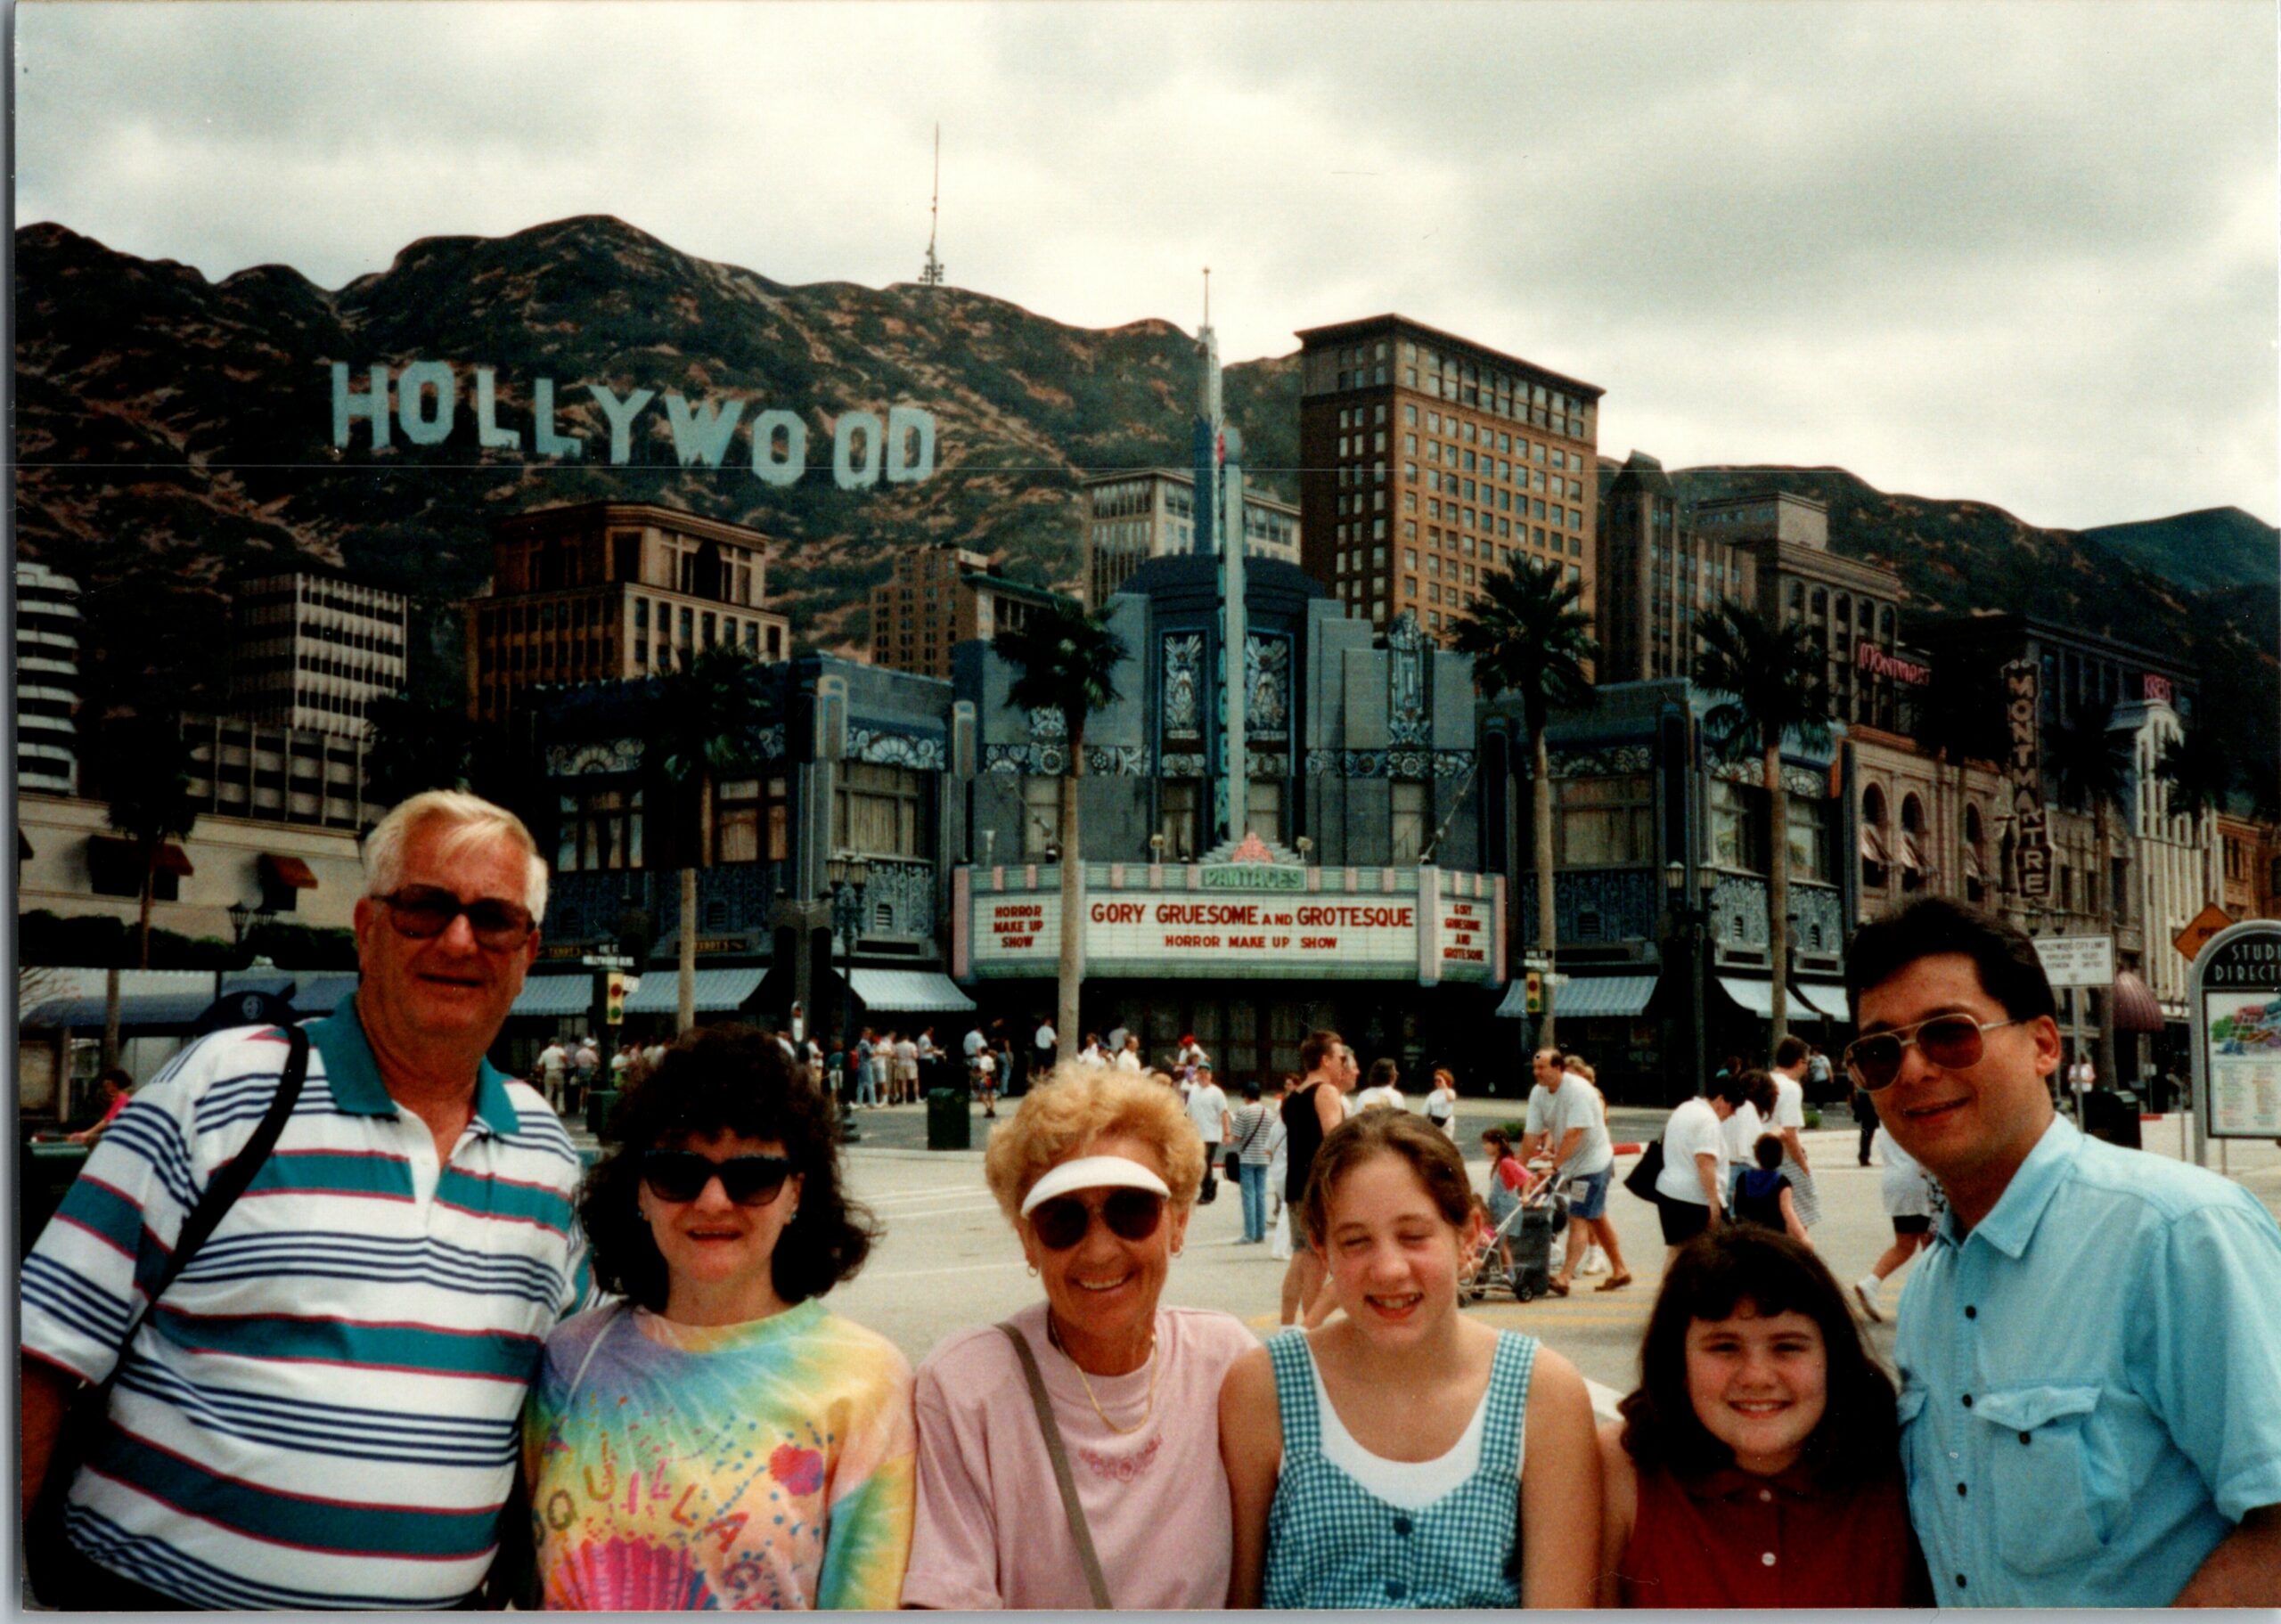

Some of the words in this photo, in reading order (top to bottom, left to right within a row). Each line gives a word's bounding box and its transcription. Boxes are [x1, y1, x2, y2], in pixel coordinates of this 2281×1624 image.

[331, 359, 936, 490] HOLLYWOOD
[2007, 674, 2046, 894] MONTMARTRE
[1205, 868, 1300, 887] PANTAGES
[994, 905, 1042, 918] HORROR
[1091, 902, 1146, 924] GORY
[1156, 903, 1259, 926] GRUESOME
[1262, 912, 1294, 926] AND
[1296, 906, 1413, 927] GROTESQUE
[1453, 903, 1472, 916] GORY
[993, 920, 1025, 933] MAKE
[1029, 919, 1043, 932] UP
[1444, 918, 1481, 932] GRUESOME
[1002, 935, 1034, 948] SHOW
[1165, 934, 1221, 948] HORROR
[1228, 935, 1265, 949] MAKE
[1272, 936, 1290, 948] UP
[1301, 936, 1337, 950] SHOW
[1455, 933, 1470, 945] AND
[1443, 947, 1484, 961] GROTESQUE
[2215, 965, 2281, 981] DIRECT
